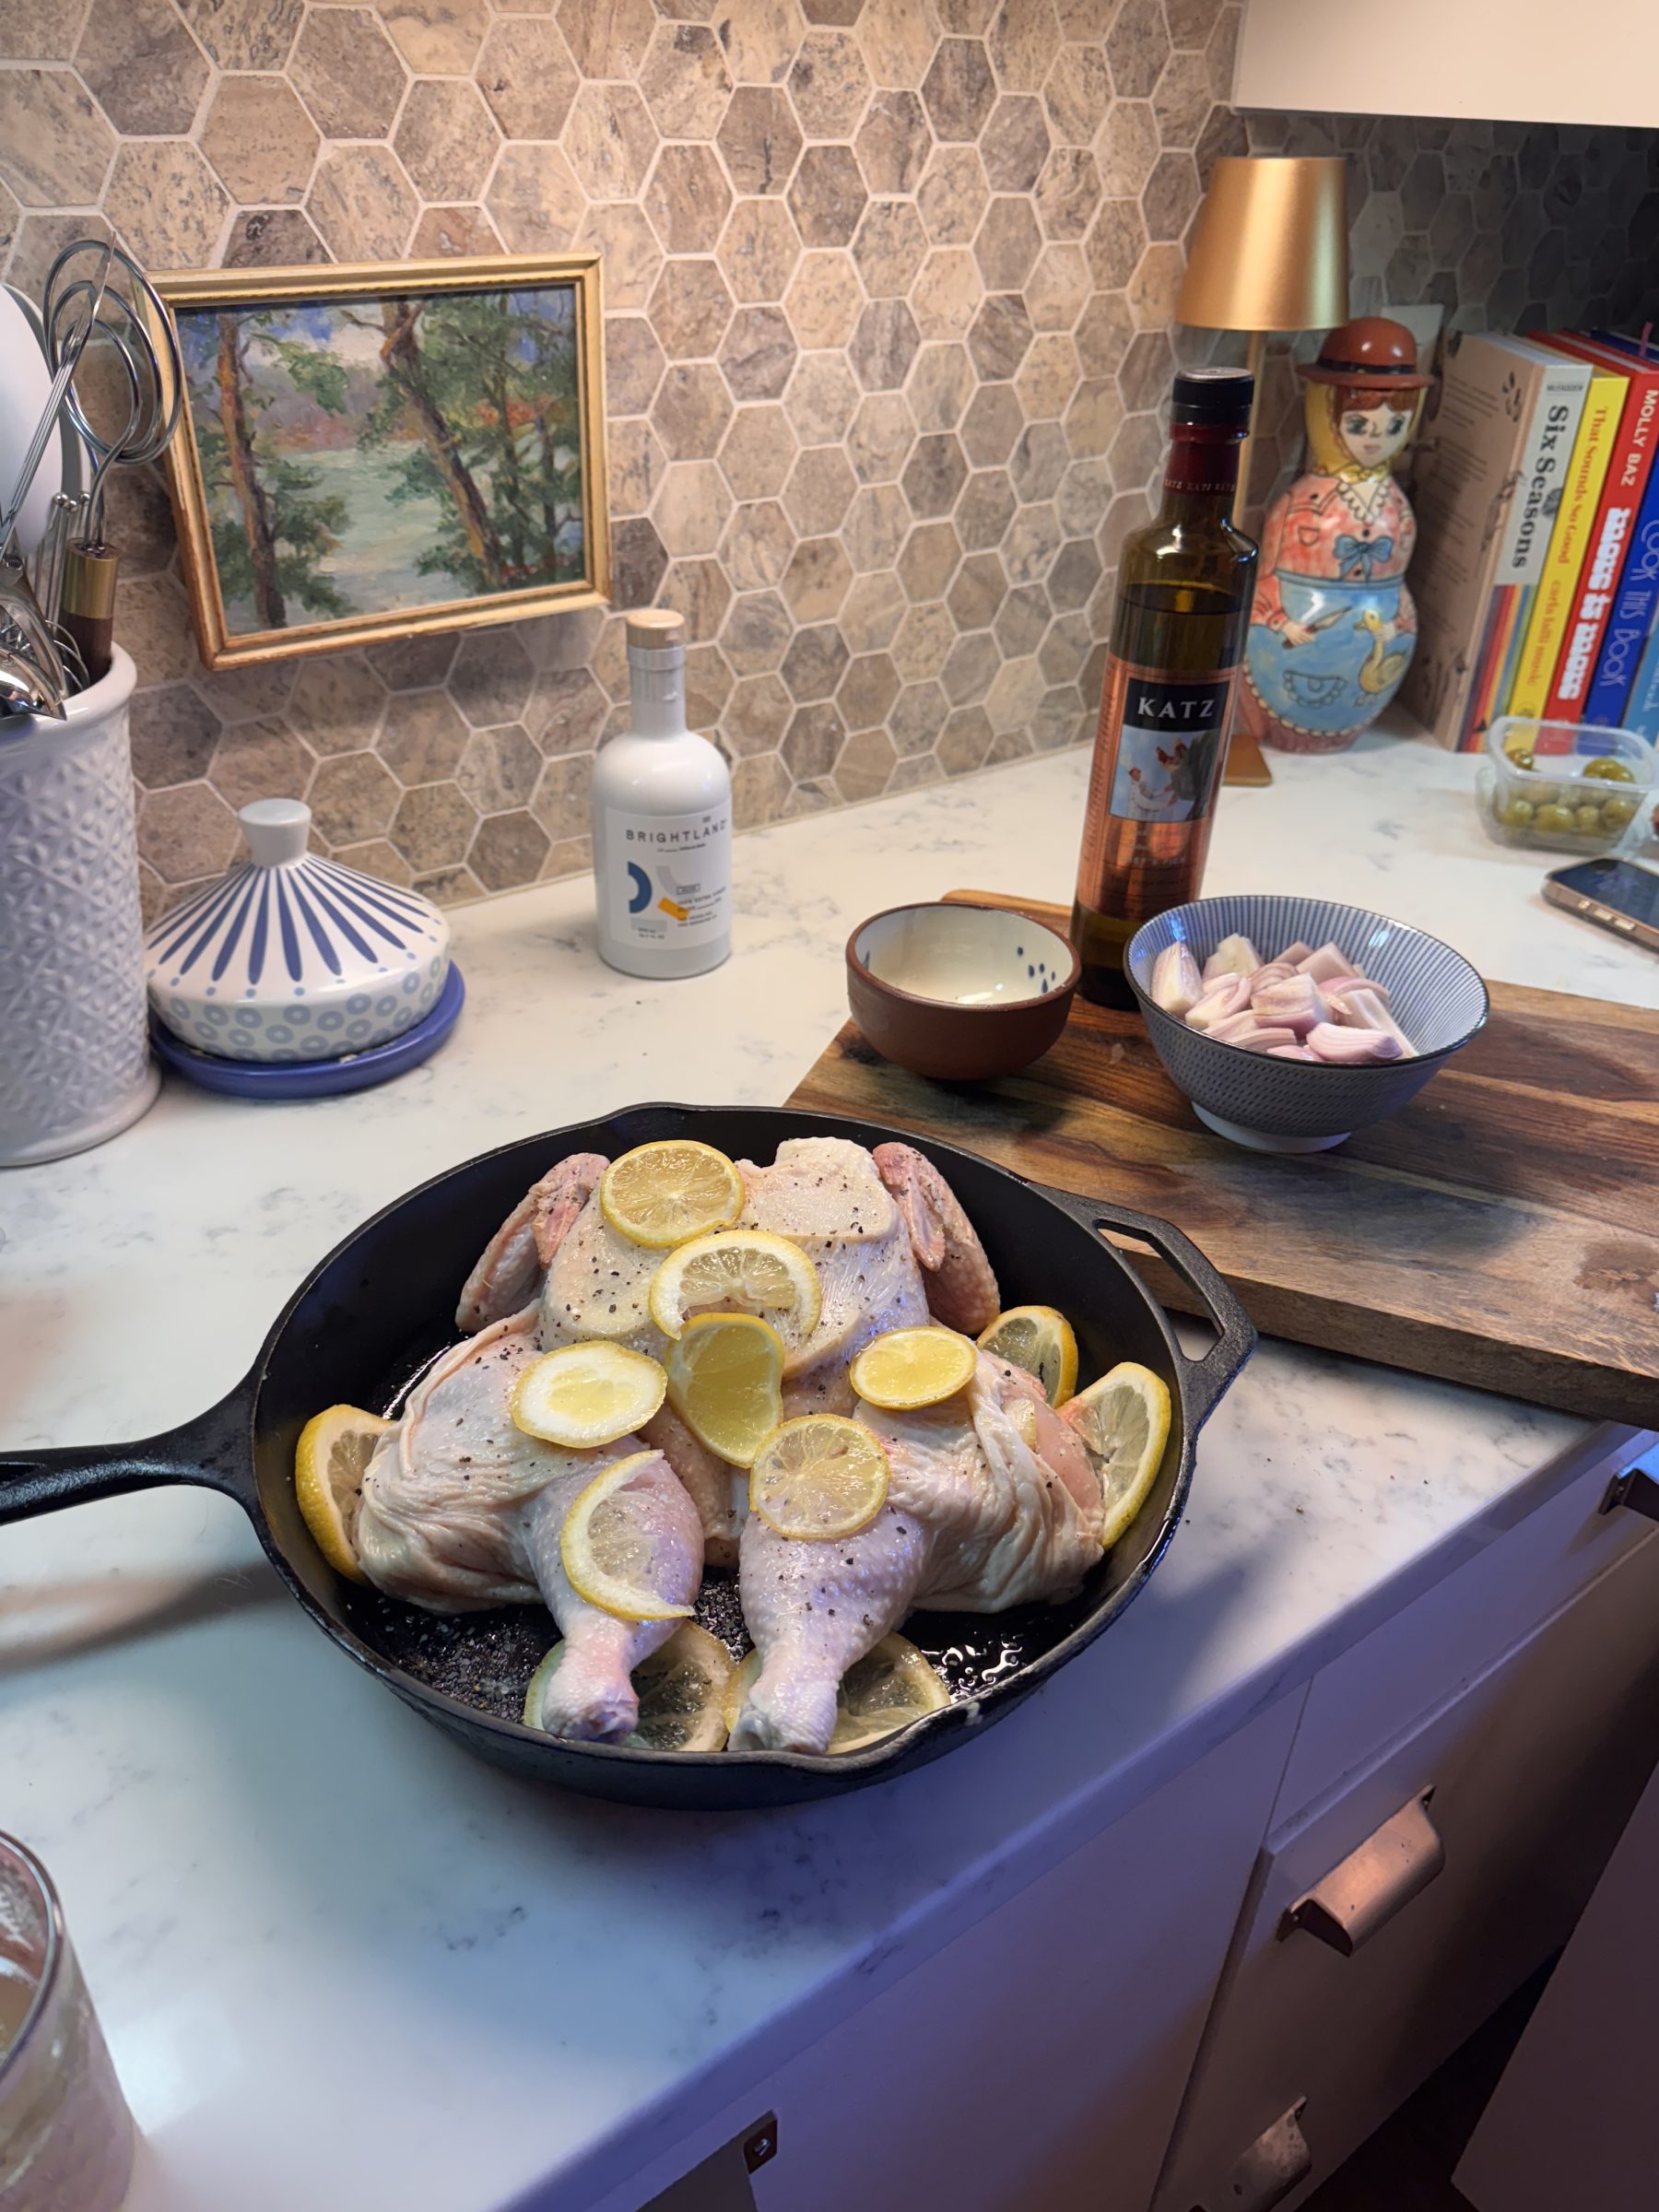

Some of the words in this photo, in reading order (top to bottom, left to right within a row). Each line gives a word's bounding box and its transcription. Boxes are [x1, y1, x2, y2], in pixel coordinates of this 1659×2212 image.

[1540, 406, 1569, 452] Six
[1588, 406, 1608, 442] That
[1632, 390, 1659, 447] MOLLY
[1574, 445, 1597, 501] Sounds
[1620, 453, 1641, 487] BAZ
[1512, 456, 1556, 568] Seasons
[1569, 504, 1584, 523] So
[1558, 524, 1577, 565] Good
[1619, 591, 1652, 620] THIS
[1137, 697, 1215, 719] KATZ
[626, 818, 726, 842] BRIGHTLAND
